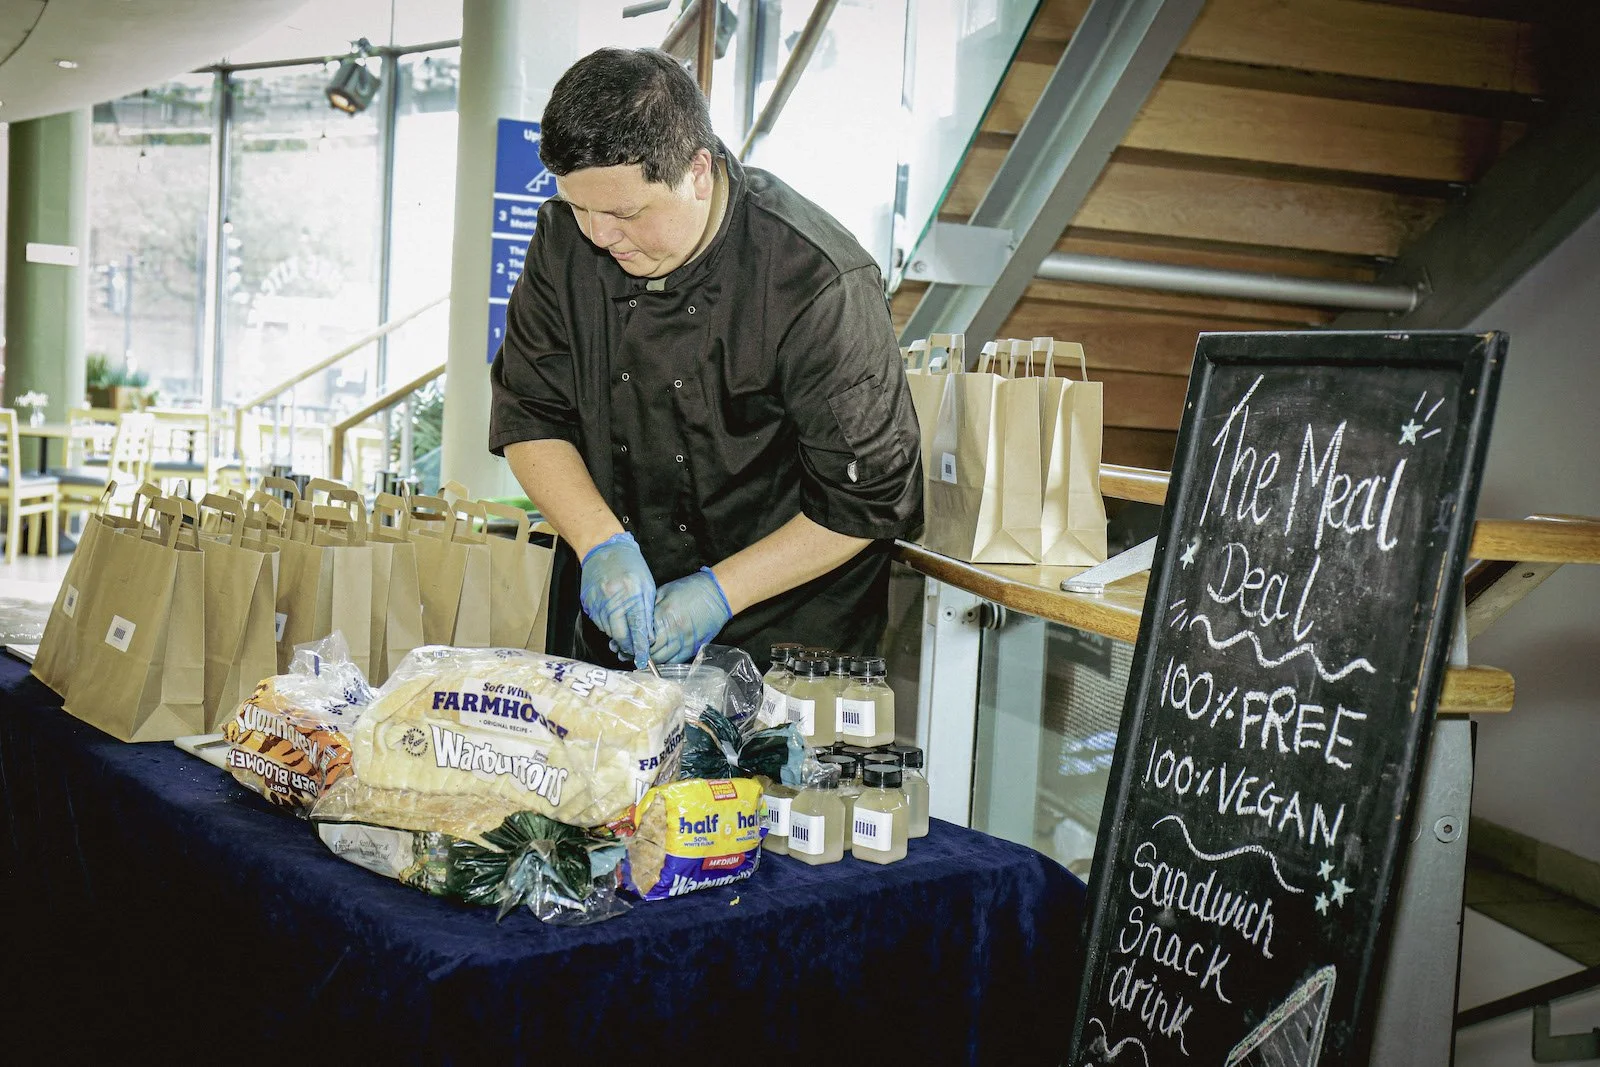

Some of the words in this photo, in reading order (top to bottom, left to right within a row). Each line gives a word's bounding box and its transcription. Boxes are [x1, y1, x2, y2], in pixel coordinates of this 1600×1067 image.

[499, 210, 507, 221] 3
[509, 246, 526, 256] The
[496, 262, 505, 274] 2
[494, 327, 501, 337] 1
[1200, 374, 1281, 527] The
[1285, 420, 1407, 551] Meal
[1207, 542, 1320, 642] Deal
[482, 682, 504, 694] Soft
[507, 686, 532, 701] Whi
[483, 719, 508, 730] ORIGINAL
[509, 725, 528, 734] RECIPE
[1160, 657, 1238, 728] 100%
[1239, 686, 1367, 770] FREE
[428, 723, 568, 807] Warburtons
[270, 783, 287, 794] SOFT
[291, 771, 318, 799] GER
[1142, 737, 1215, 797] 100%
[1217, 762, 1345, 848] VEGAN
[678, 813, 719, 834] half
[737, 809, 758, 829] hal
[708, 857, 740, 867] MEDIUM
[1129, 842, 1273, 959] Sandwich
[1119, 906, 1232, 1003] Snack
[1108, 958, 1193, 1056] drink
